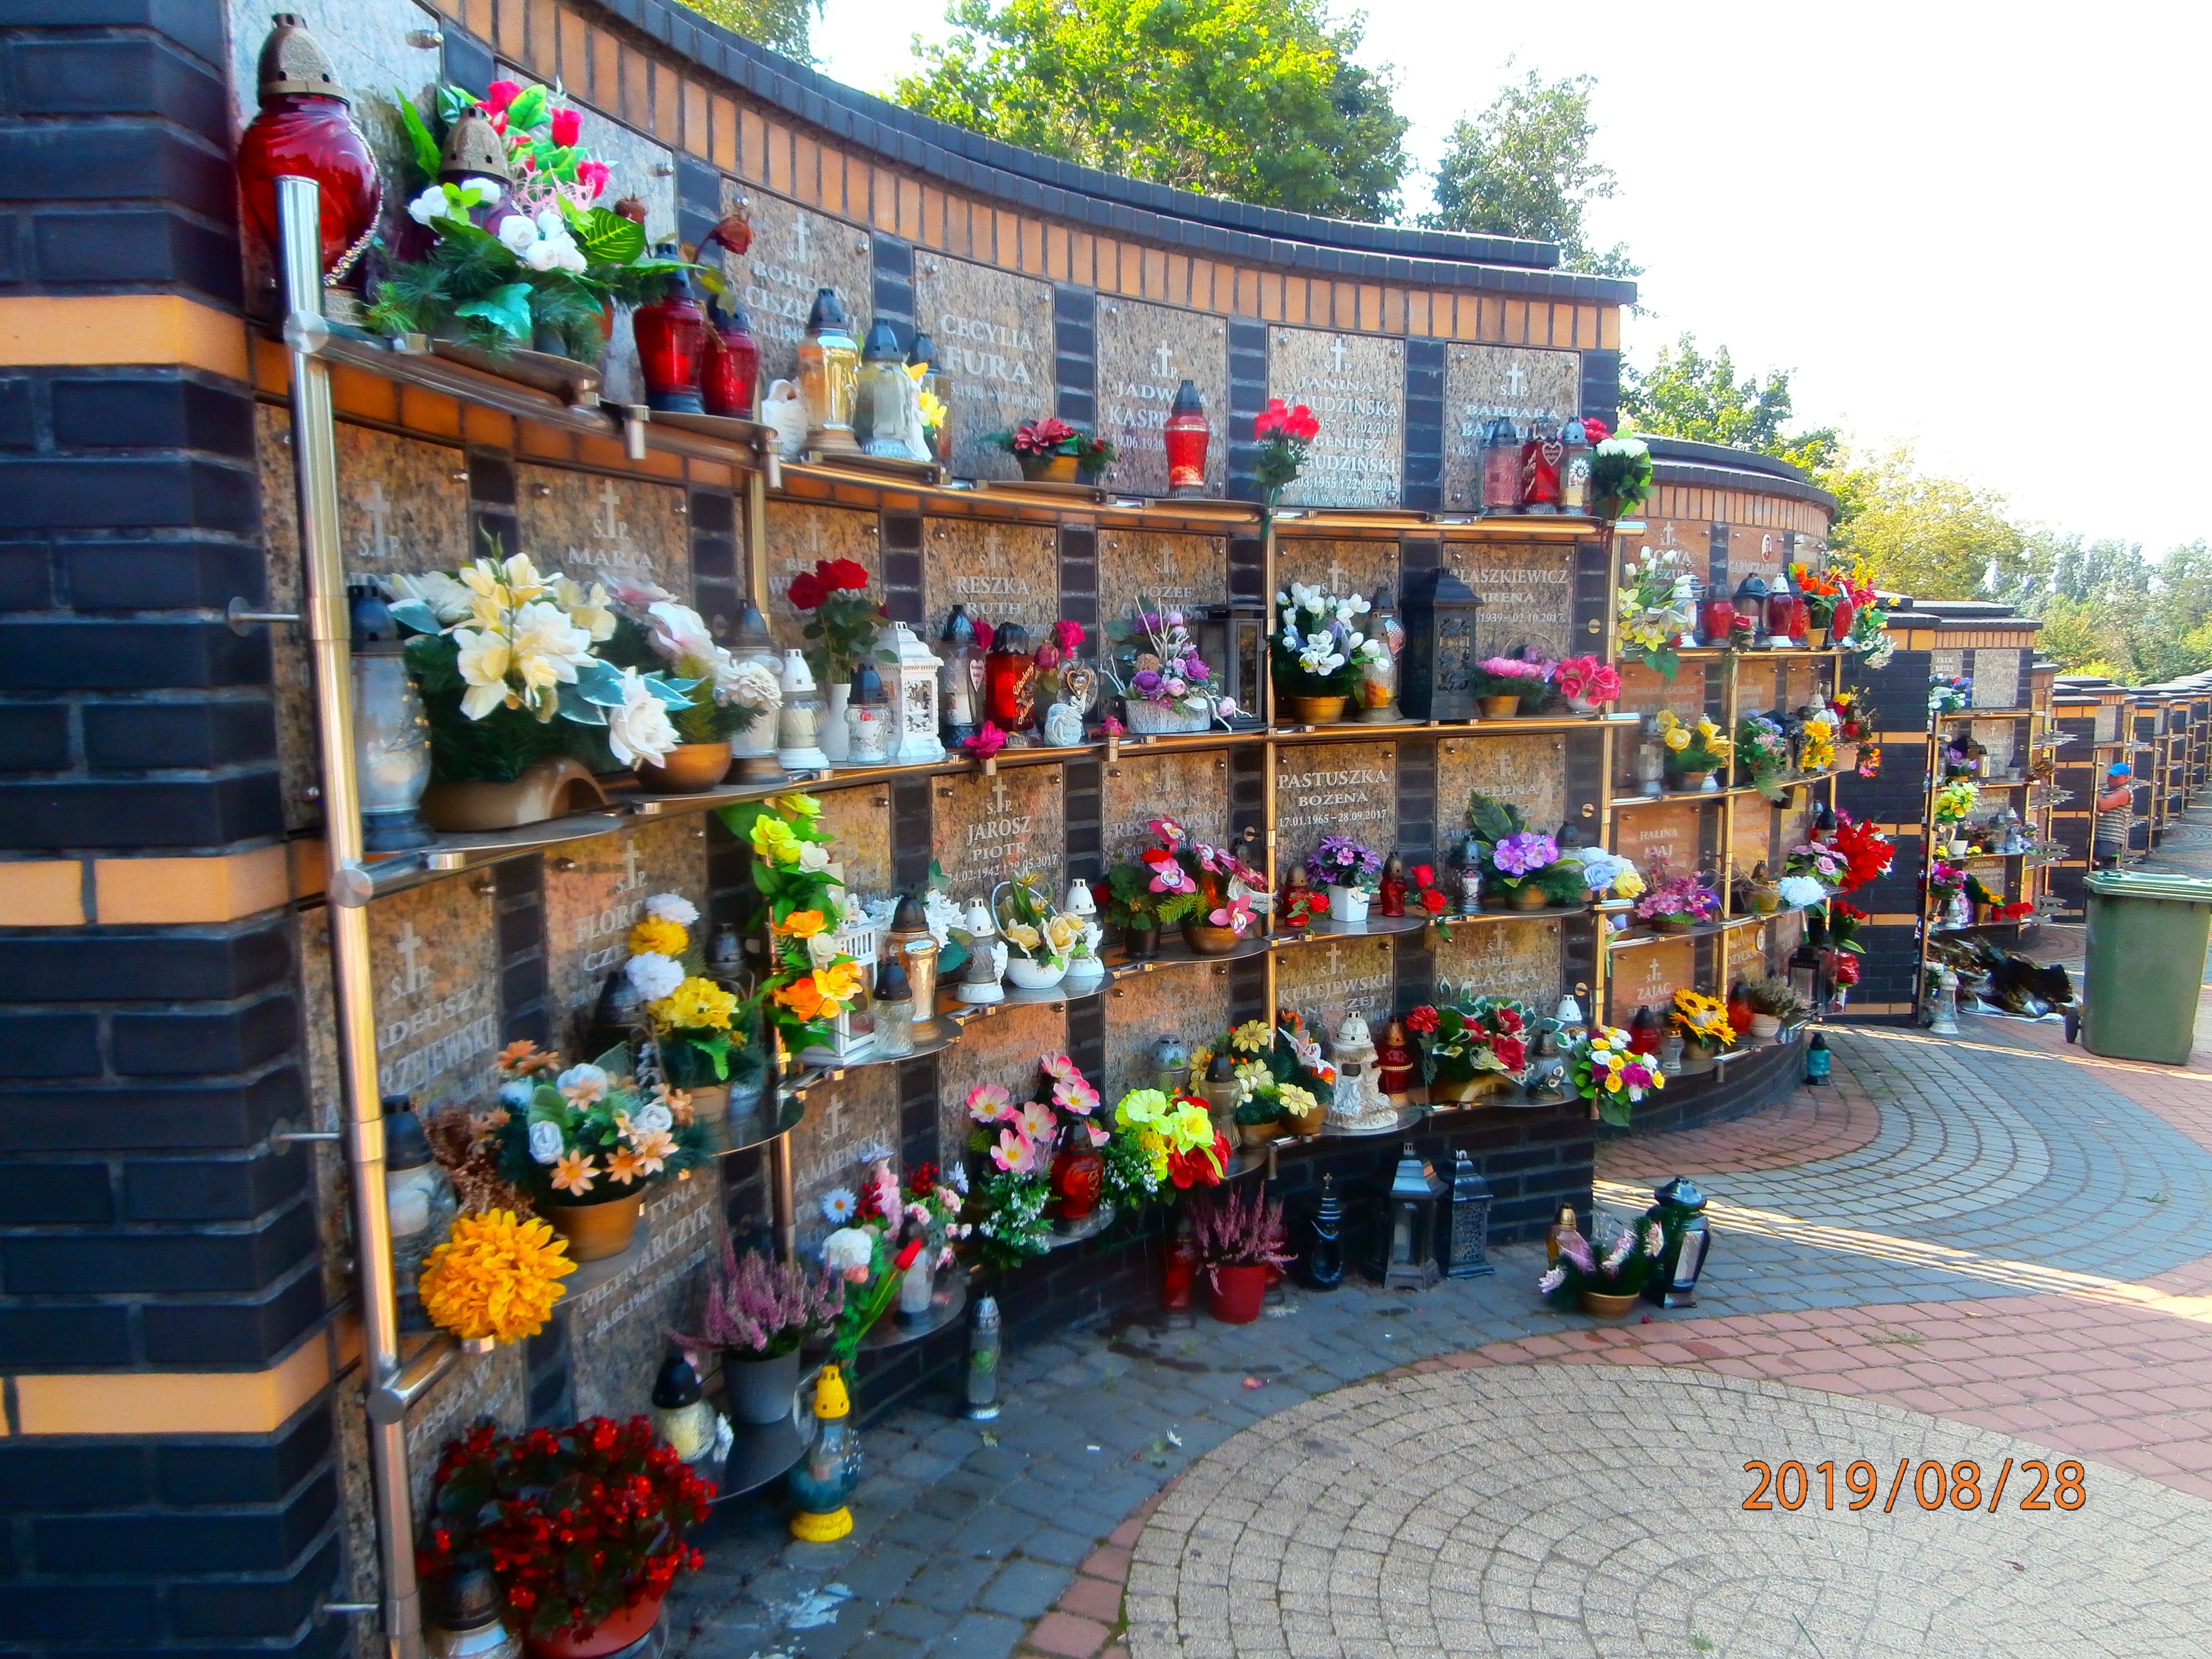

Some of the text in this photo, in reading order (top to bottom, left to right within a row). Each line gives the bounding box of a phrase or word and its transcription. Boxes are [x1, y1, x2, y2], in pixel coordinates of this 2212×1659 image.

[753, 259, 848, 302] BOHDN
[940, 314, 1034, 352] CECYLIA
[945, 345, 1032, 385] FURA
[1299, 375, 1374, 393] JANINA
[1117, 381, 1209, 407] JADWA
[1466, 405, 1560, 420] BARBARA
[1346, 421, 1398, 435] 24.02.2018
[1346, 478, 1397, 491] 22.08.2019
[568, 546, 654, 569] MARIA
[956, 577, 1030, 595] RESZKA
[1482, 592, 1536, 603] IRENA
[966, 602, 1022, 615] RUTH
[1277, 769, 1388, 789] PASTUSZKA
[1005, 800, 1013, 812] P.
[1298, 791, 1369, 807] BOŻENA
[1278, 814, 1329, 827] 17.01.1965
[1338, 809, 1387, 822] 28.09.2017
[967, 816, 1032, 846] JAROSZ
[1640, 828, 1678, 840] HALINA
[972, 842, 1028, 862] PIOTR
[1277, 974, 1388, 1004] KULEJEWSKI
